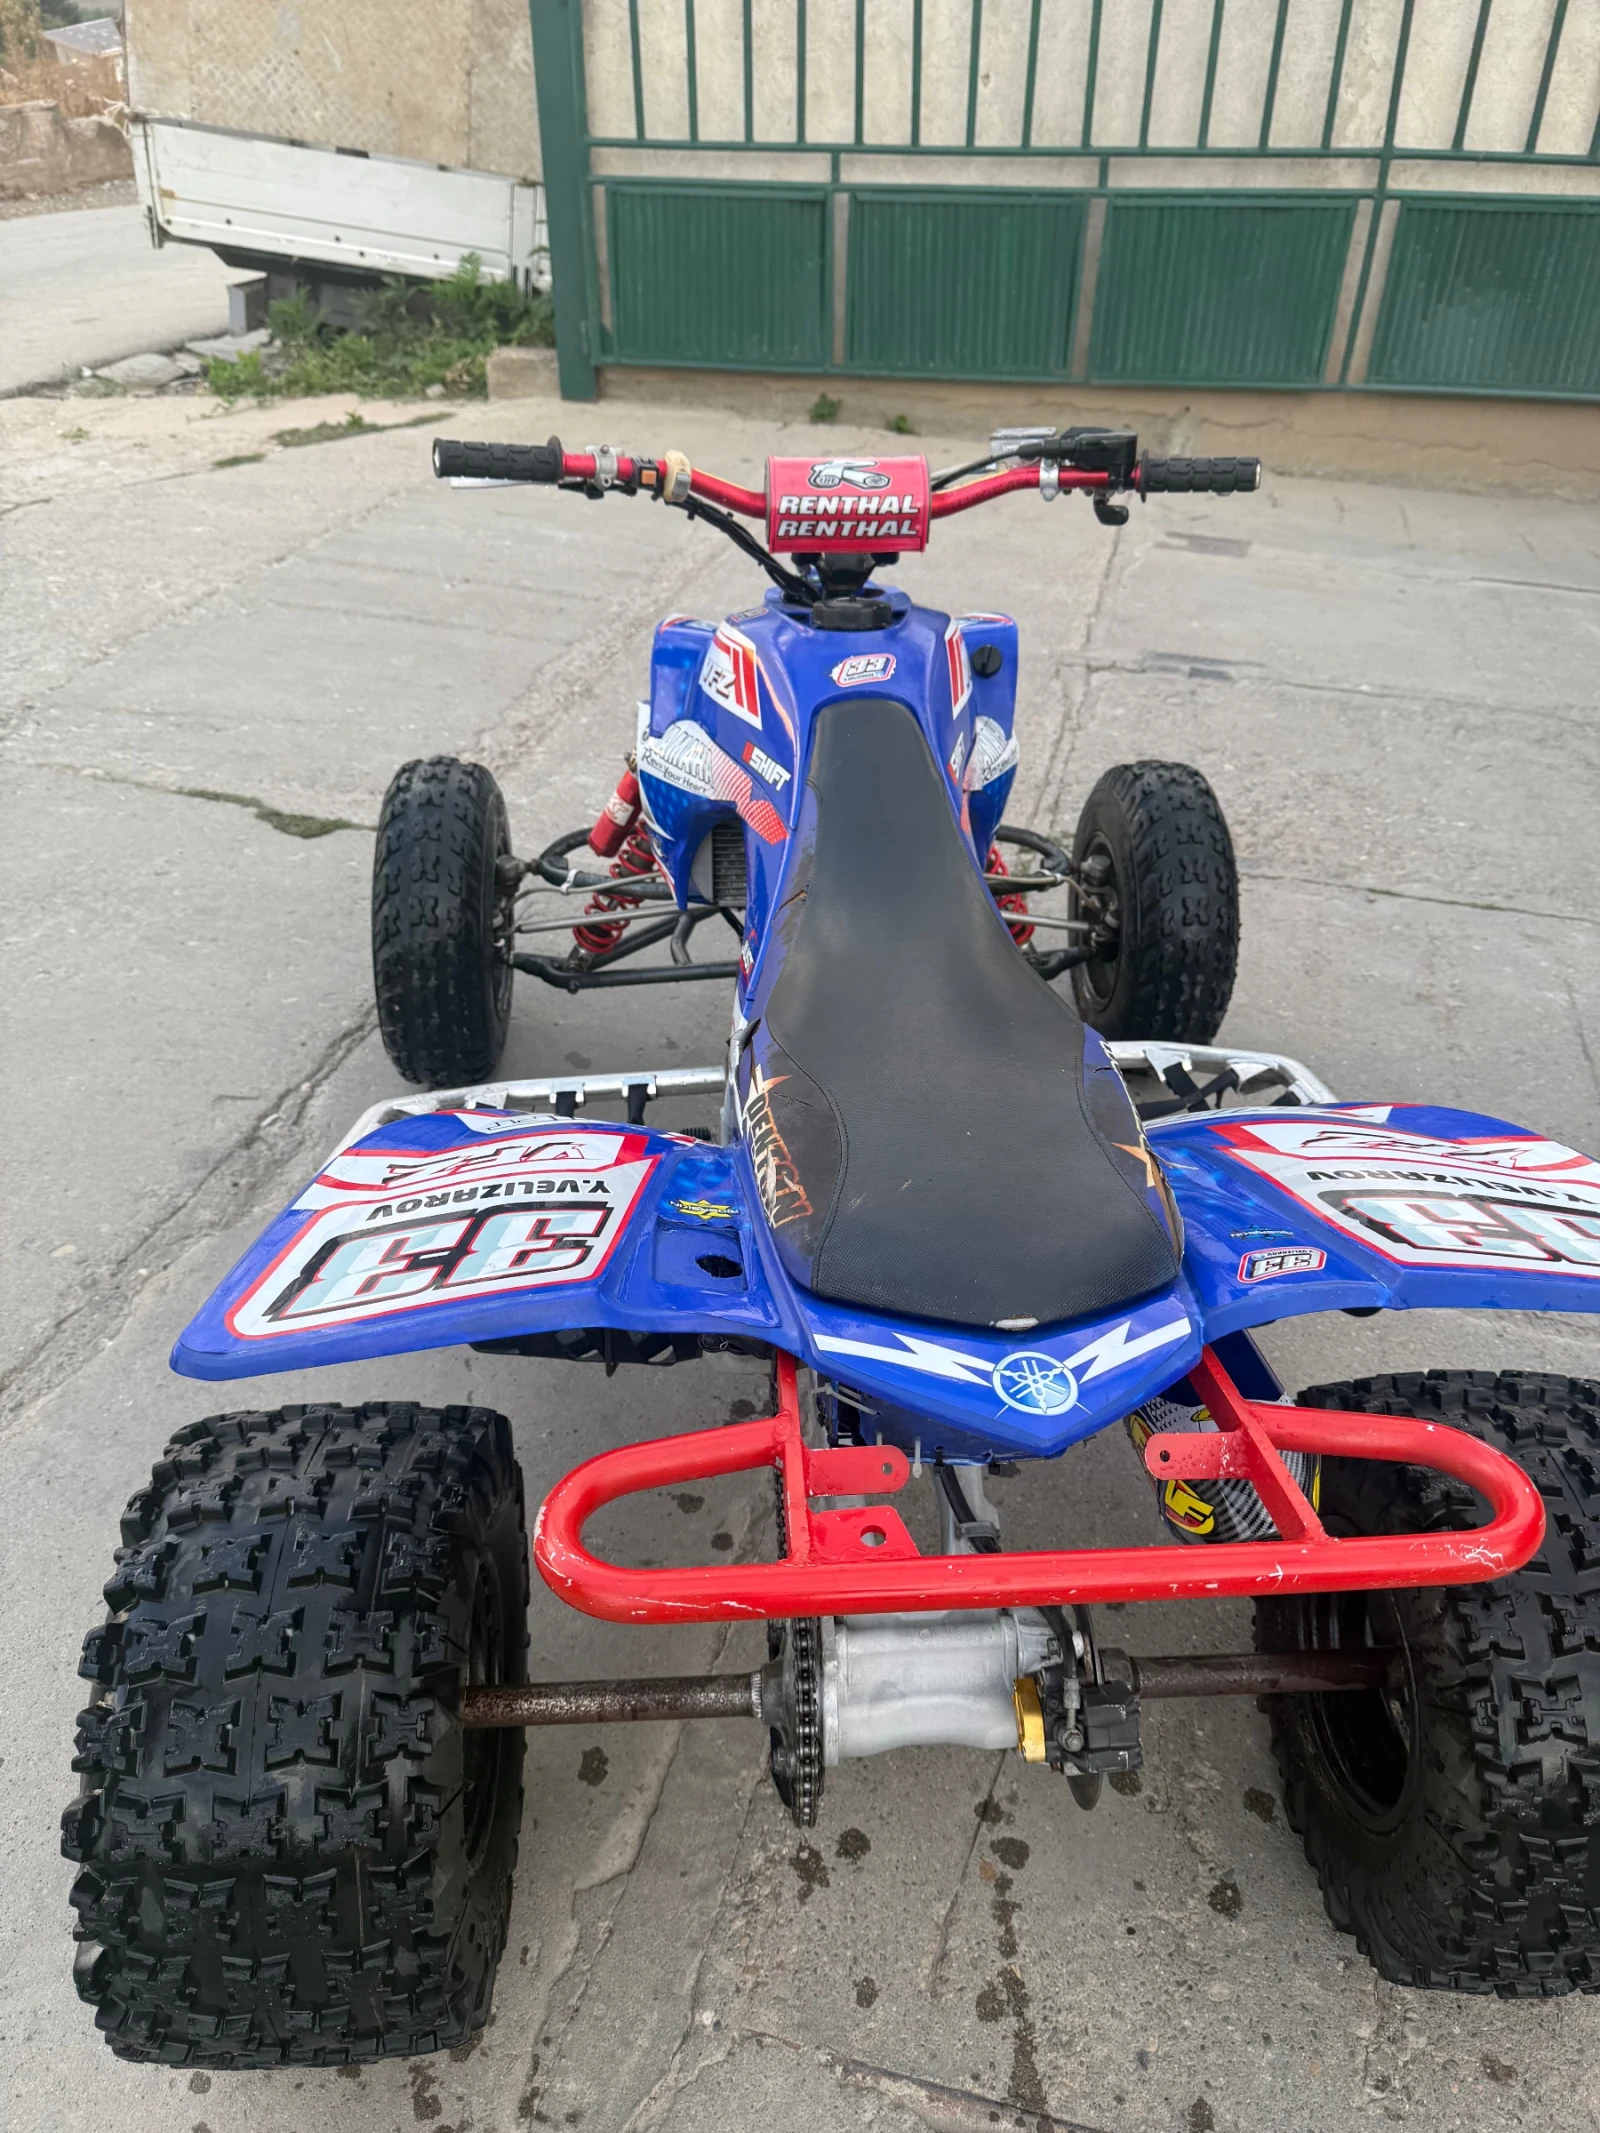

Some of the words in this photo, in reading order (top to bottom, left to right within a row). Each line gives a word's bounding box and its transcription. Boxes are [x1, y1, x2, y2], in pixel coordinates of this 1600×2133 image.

[778, 495, 919, 515] RENTHAL
[777, 519, 917, 537] RENTHAL
[847, 657, 888, 676] 33
[663, 766, 683, 782] Your
[682, 777, 708, 794] Heart
[748, 746, 792, 792] SHIFT
[366, 1178, 611, 1220] Y.VELIZAROV
[264, 1202, 613, 1321] 33
[1250, 1254, 1312, 1278] 33
